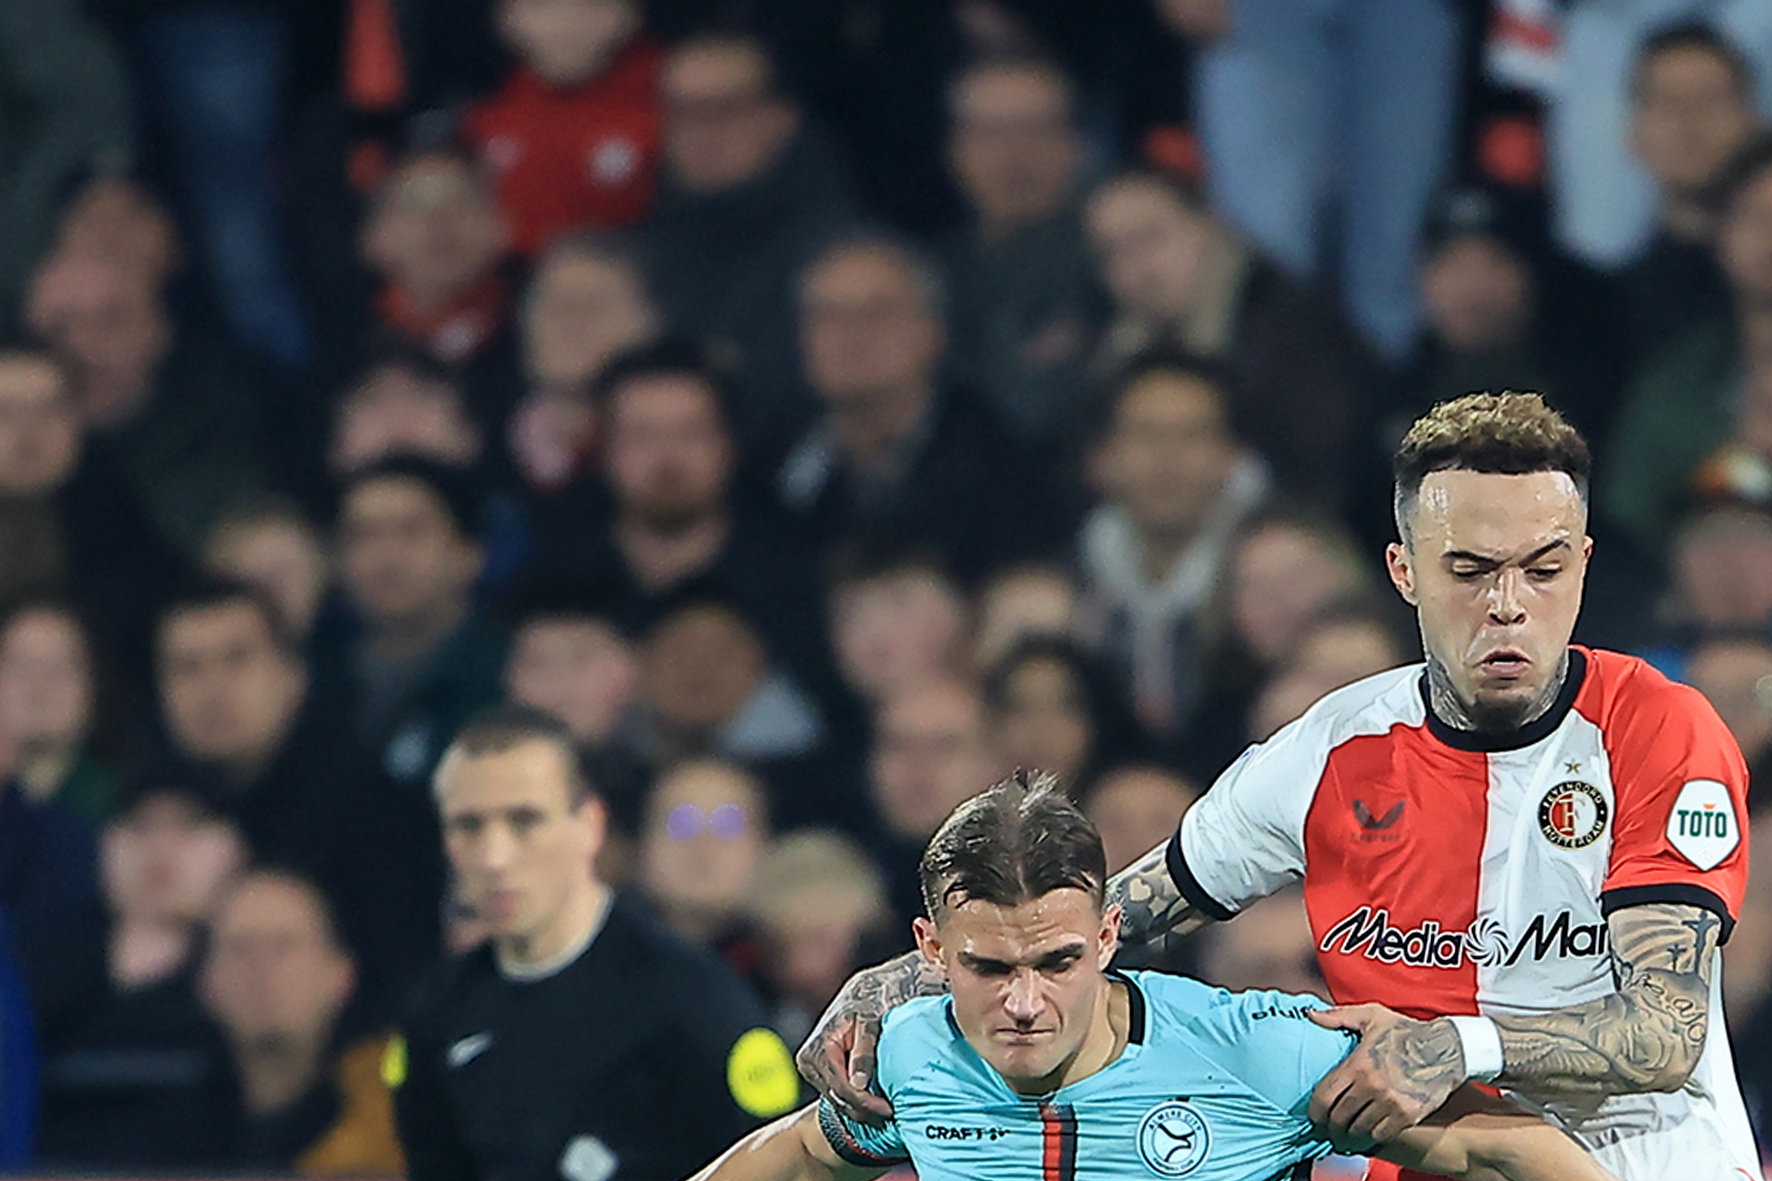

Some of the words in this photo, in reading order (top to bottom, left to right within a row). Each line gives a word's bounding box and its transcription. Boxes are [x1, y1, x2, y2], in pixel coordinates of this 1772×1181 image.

[1677, 810, 1727, 838] TOTO
[1321, 907, 1464, 968] Media
[1502, 910, 1608, 968] Mar
[925, 1124, 985, 1140] CRAFT
